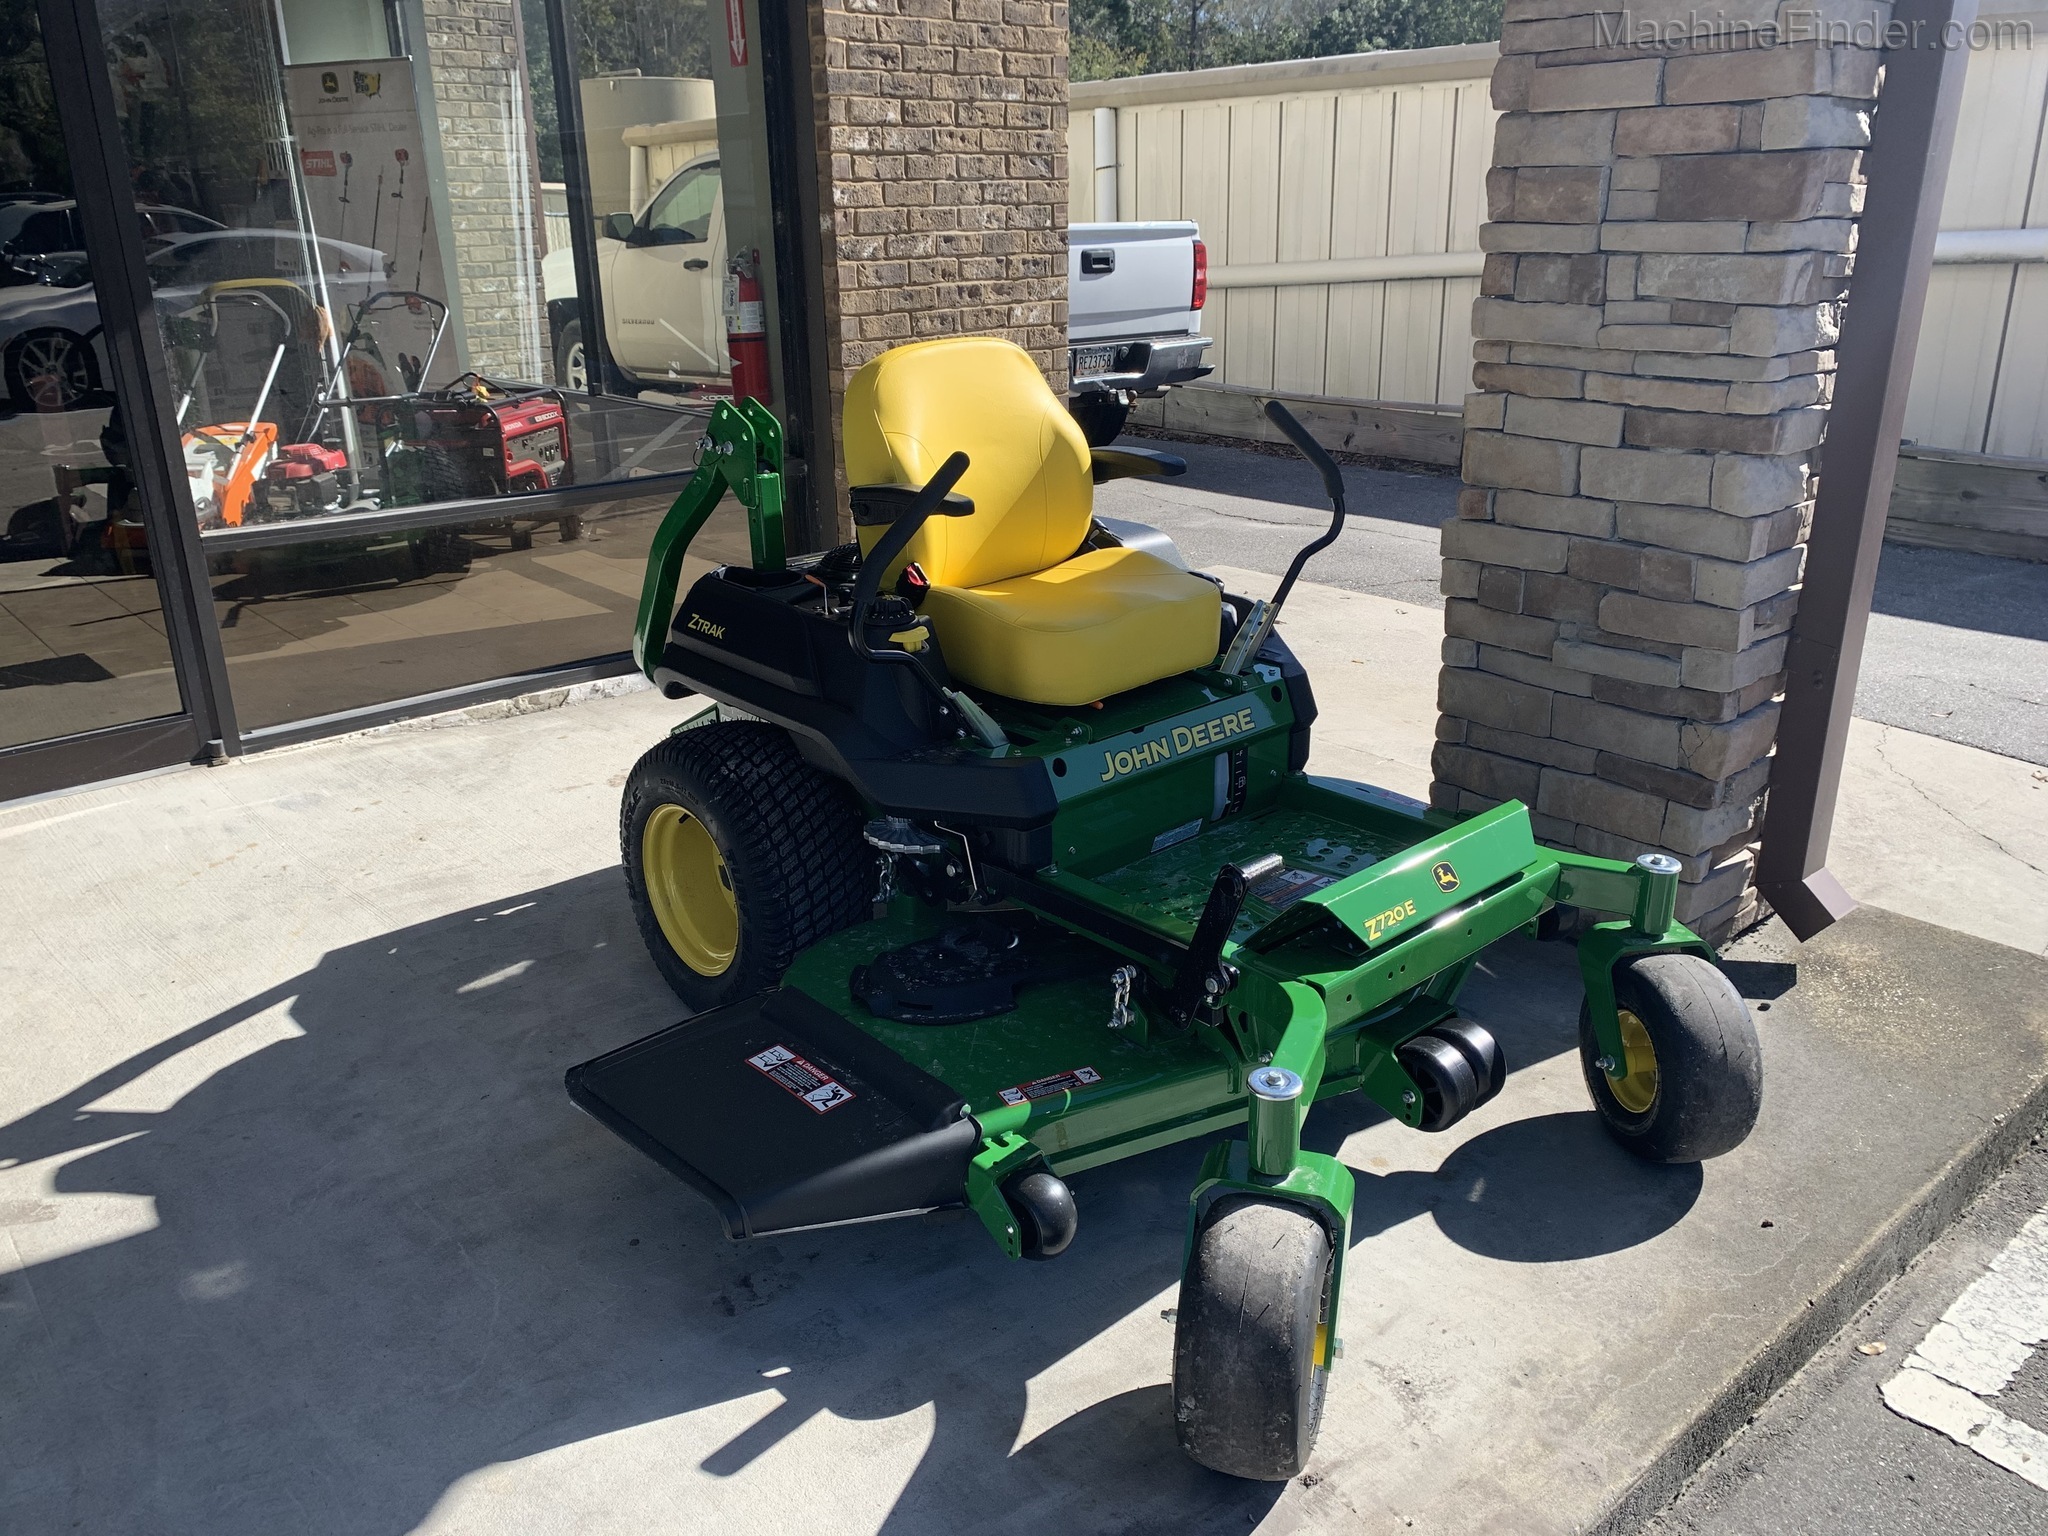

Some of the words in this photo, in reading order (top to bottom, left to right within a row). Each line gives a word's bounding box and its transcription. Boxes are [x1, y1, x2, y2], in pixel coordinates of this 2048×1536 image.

[305, 158, 333, 169] STIHL
[1078, 354, 1112, 370] REZ3758
[687, 613, 726, 640] ZTRAK
[1100, 736, 1172, 782] JOHN
[1171, 707, 1256, 755] DEERE
[802, 1062, 830, 1081] DANGER
[1036, 1074, 1061, 1084] DANGER
